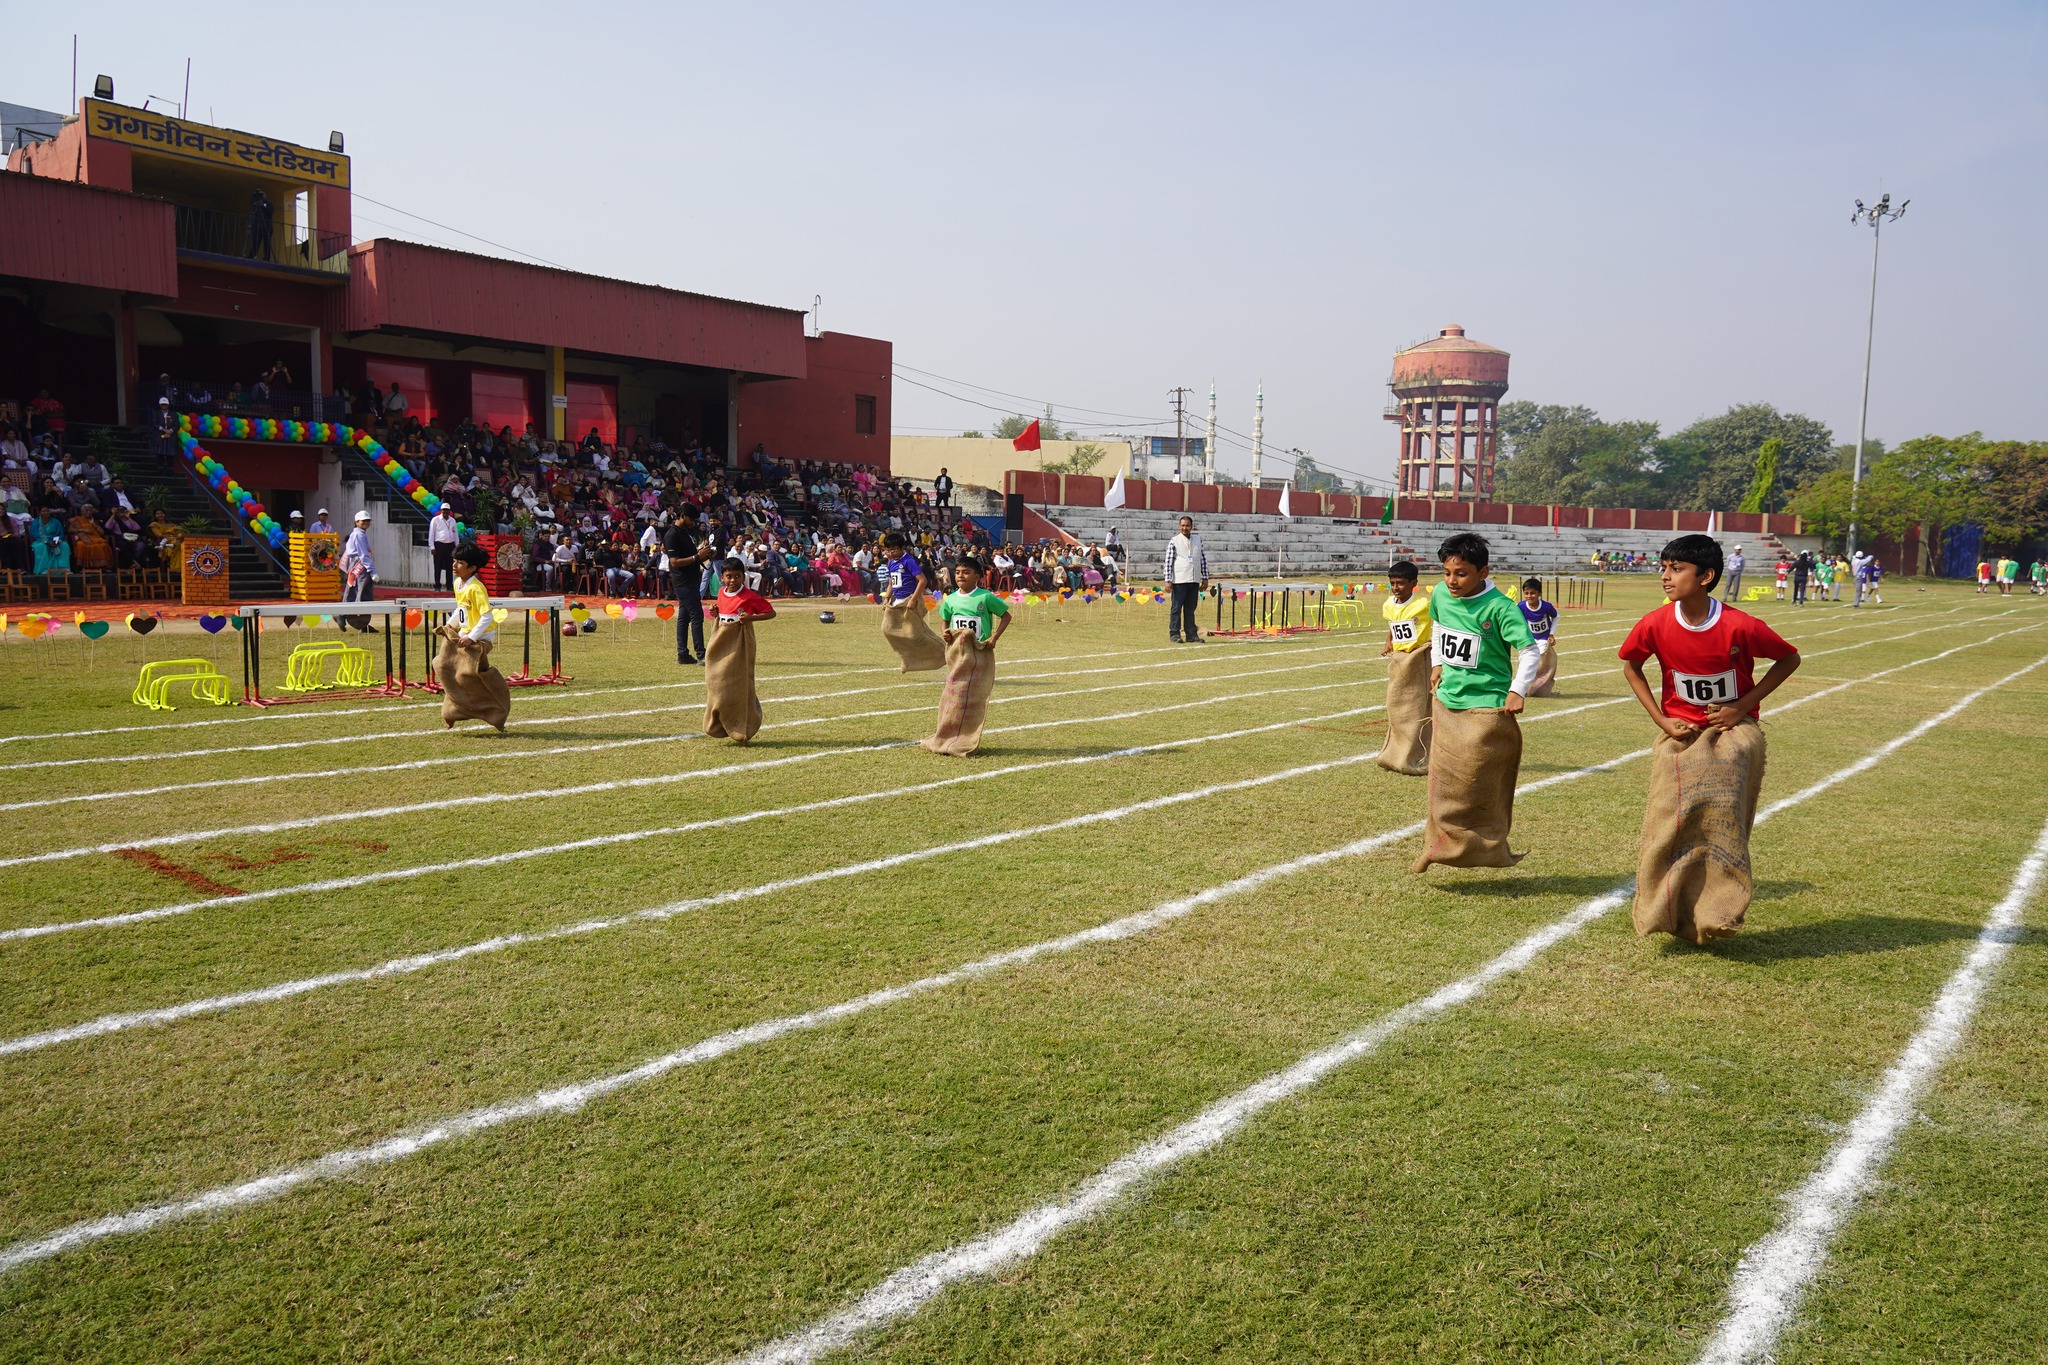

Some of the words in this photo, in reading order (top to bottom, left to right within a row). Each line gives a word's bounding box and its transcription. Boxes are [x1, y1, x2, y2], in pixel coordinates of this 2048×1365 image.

[97, 109, 232, 157] जगजीवन
[236, 141, 339, 179] स्टेडियम
[1392, 623, 1413, 640] 155
[1530, 621, 1547, 632] 156
[1441, 632, 1472, 662] 154
[1681, 677, 1727, 701] 161
